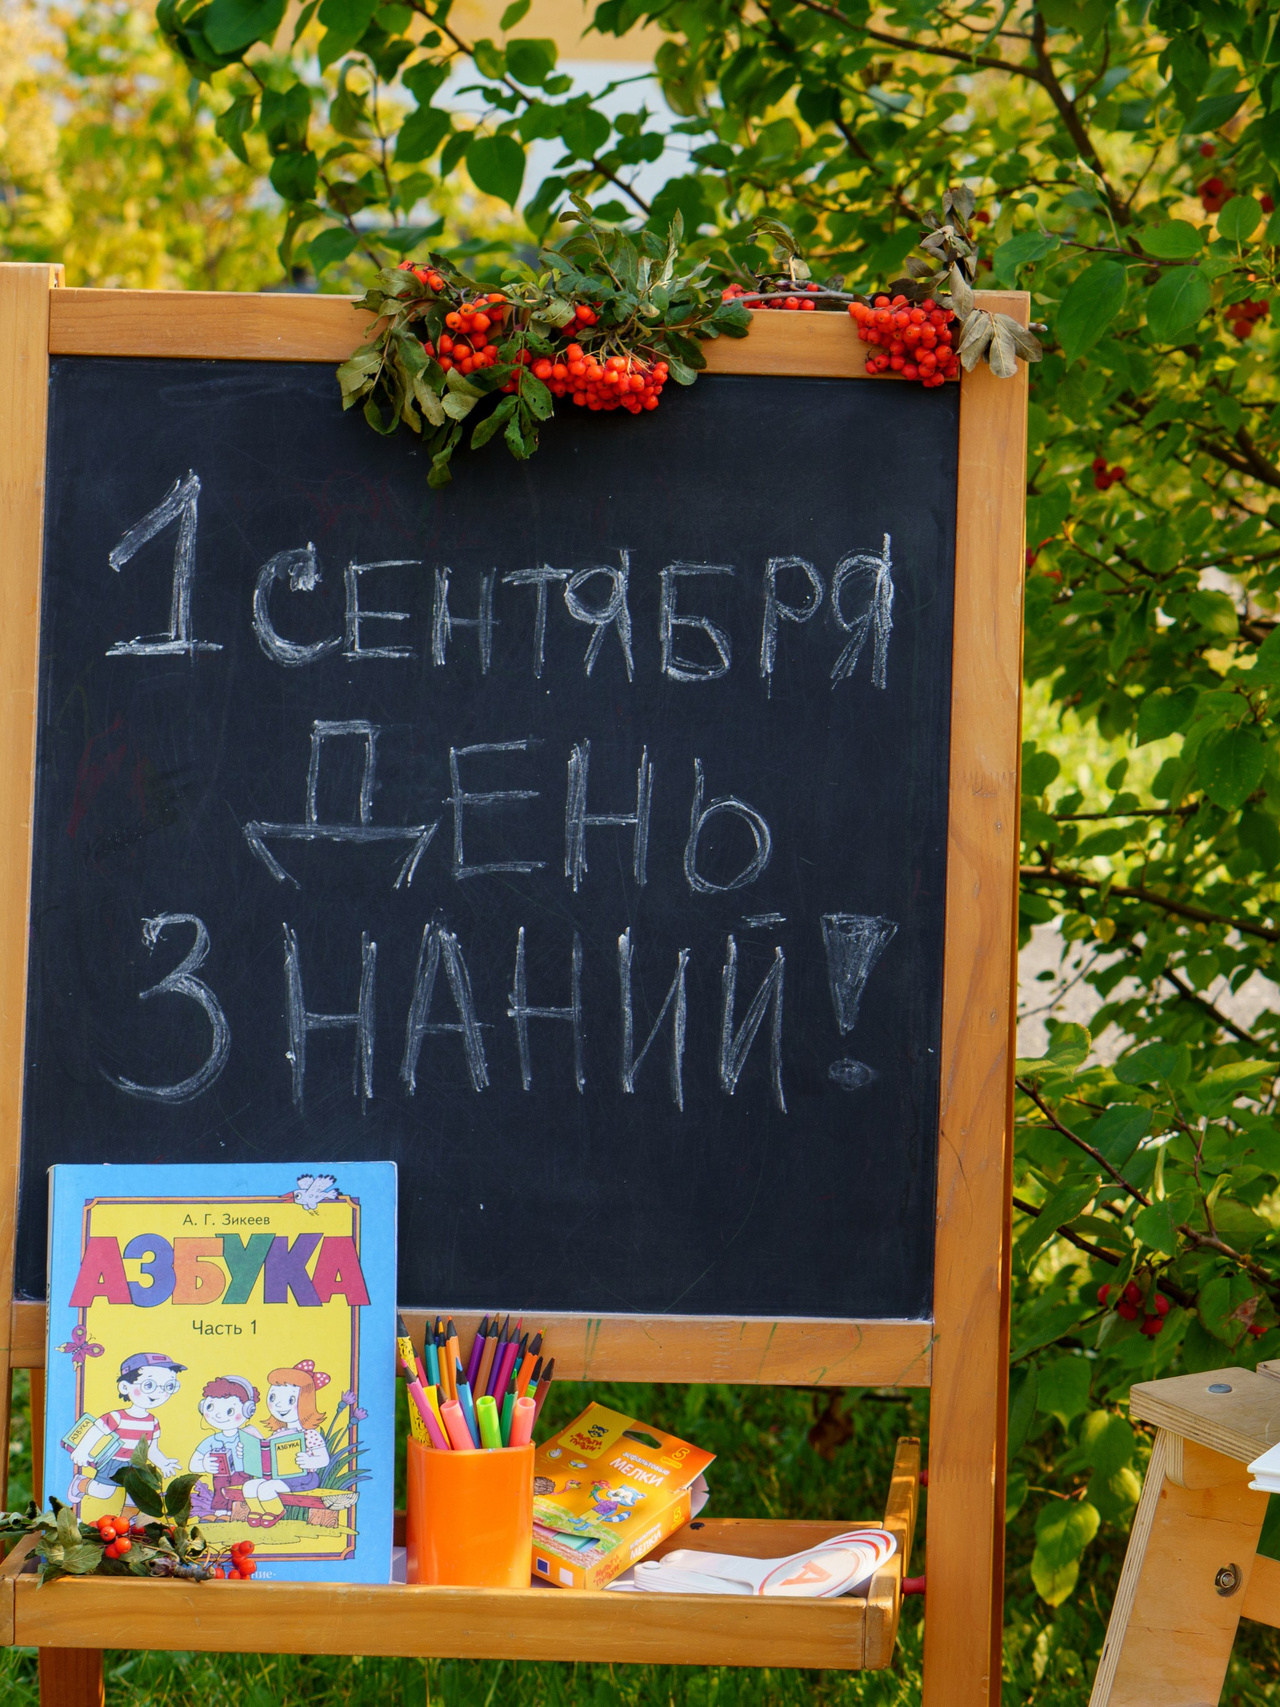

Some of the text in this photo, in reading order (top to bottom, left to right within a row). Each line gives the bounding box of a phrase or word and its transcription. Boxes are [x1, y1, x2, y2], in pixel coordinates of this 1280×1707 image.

[106, 469, 895, 692] 1 СЕНТЯБРЯ
[242, 719, 774, 893] ДЕНЬ
[98, 908, 900, 1115] ЗНАНИЙ!
[182, 1213, 271, 1226] А. Г. Зикеев
[68, 1232, 372, 1308] АЗБУКА
[192, 1319, 258, 1336] Часть 1
[70, 1420, 91, 1441] АЗБУКА
[276, 1441, 300, 1451] АЗБУКА
[671, 1447, 690, 1461] 5
[609, 1457, 665, 1487] МЕЛКИ
[629, 1529, 662, 1561] МЕЛКИ
[779, 1560, 833, 1587] А
